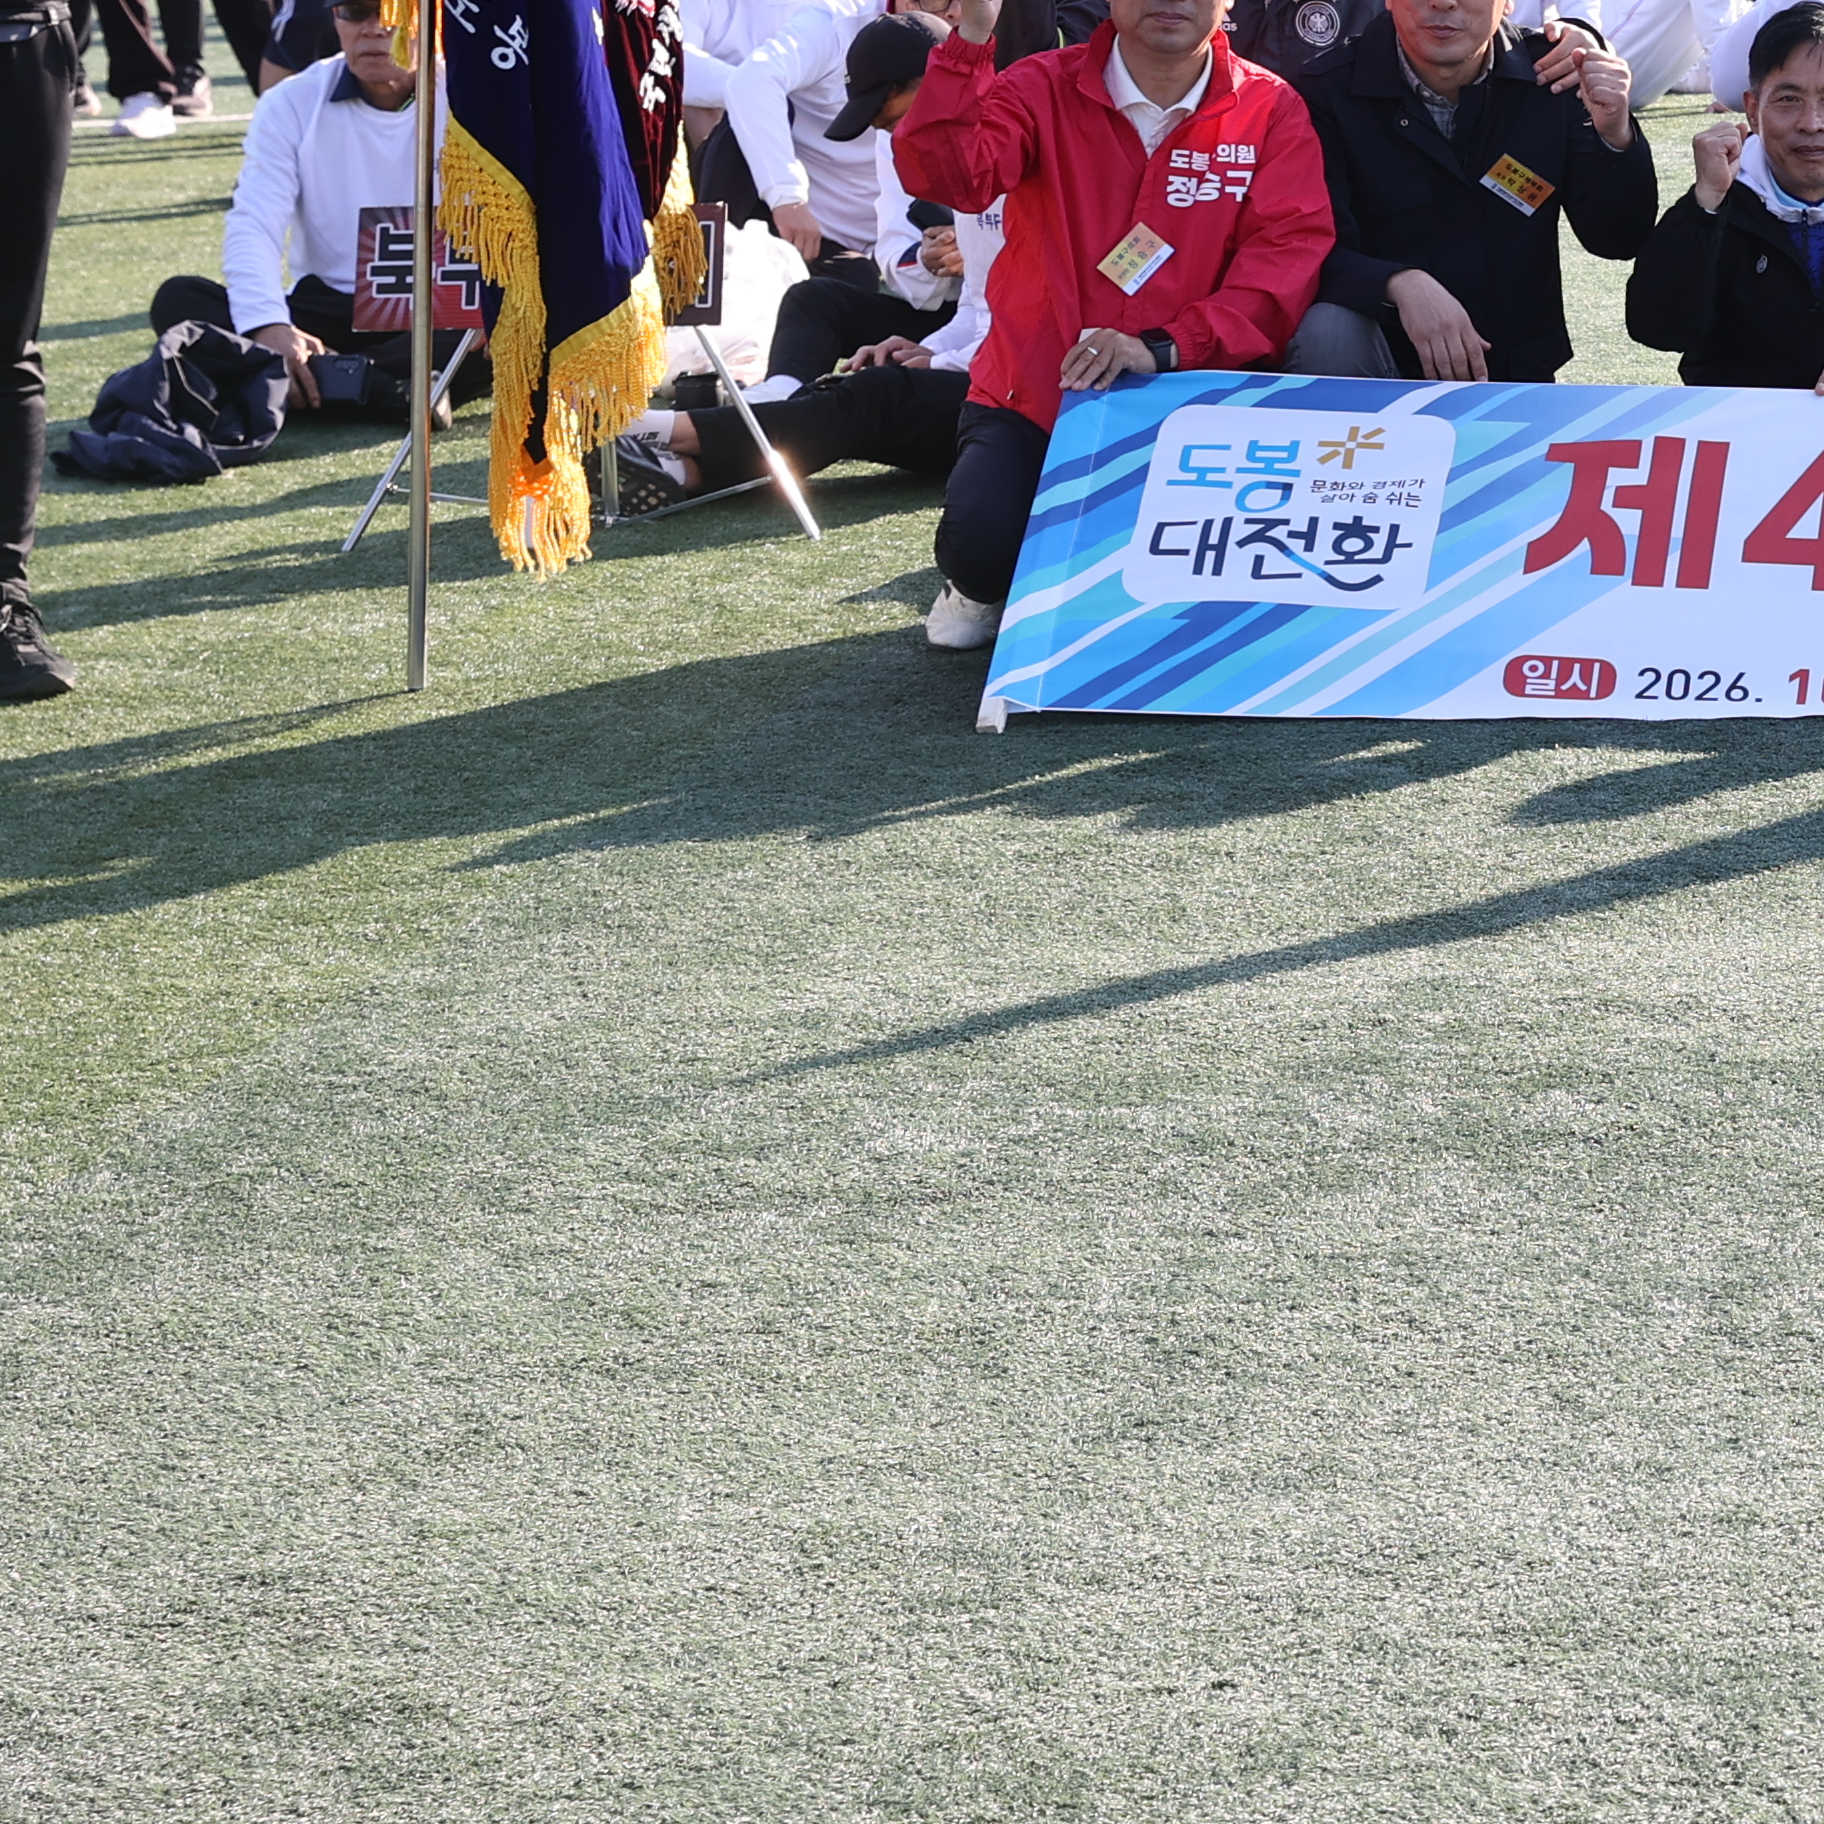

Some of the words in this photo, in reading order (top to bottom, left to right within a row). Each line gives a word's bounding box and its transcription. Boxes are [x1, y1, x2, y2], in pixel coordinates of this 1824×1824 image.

[1169, 143, 1256, 172] 도봉의원
[1165, 438, 1303, 514] 도봉
[1309, 479, 1366, 494] 문화와
[1371, 478, 1427, 490] 경제가
[1320, 492, 1357, 504] 살아
[1361, 491, 1379, 504] 숨
[1385, 491, 1423, 508] 쉬는
[1148, 513, 1413, 593] 대전환
[1521, 659, 1601, 699] 일시
[1634, 666, 1764, 704] 2026.
